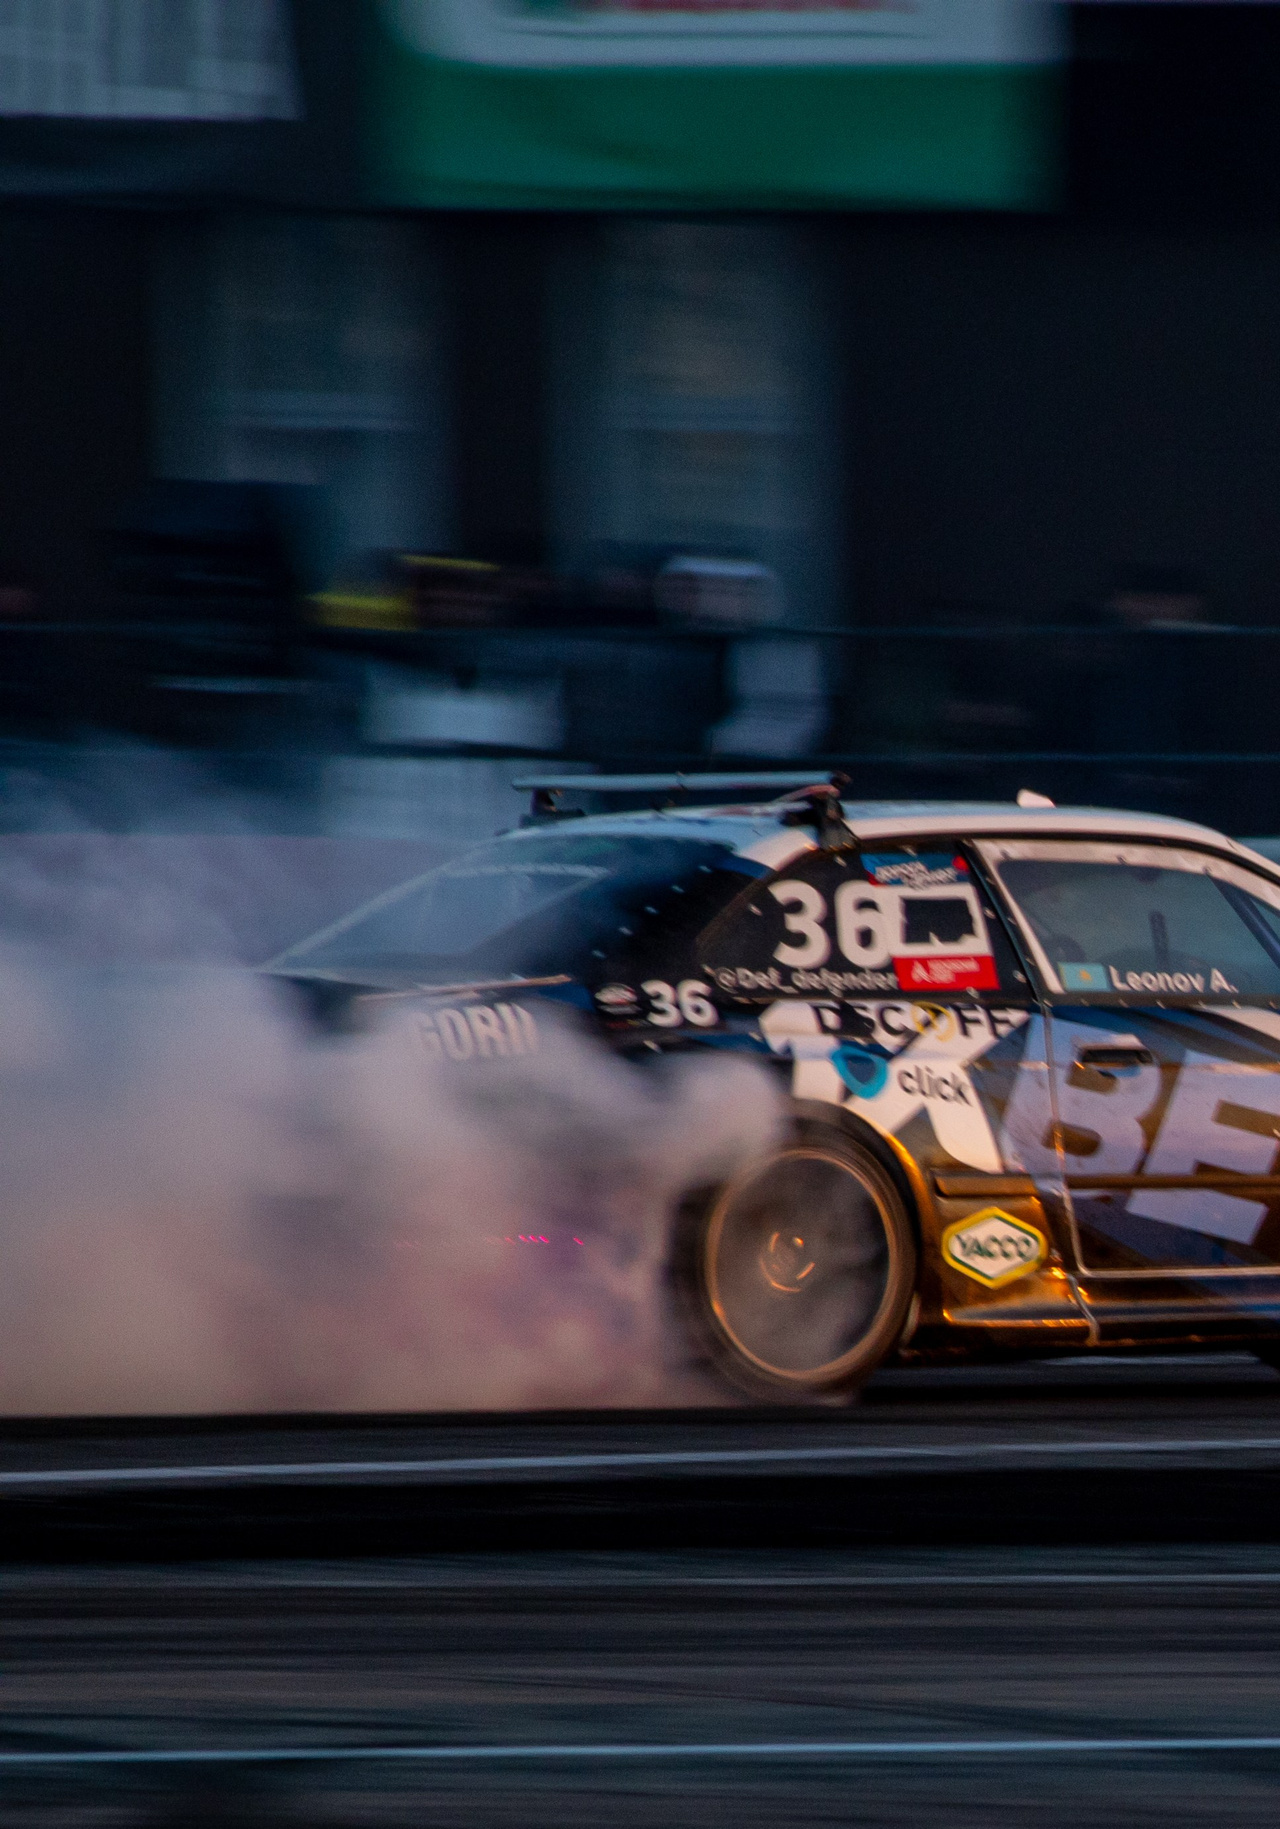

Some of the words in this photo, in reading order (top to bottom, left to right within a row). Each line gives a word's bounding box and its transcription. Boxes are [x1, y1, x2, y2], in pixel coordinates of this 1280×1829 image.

[767, 879, 893, 969] 36
[1109, 965, 1205, 993] Leonov
[1210, 967, 1239, 994] A.
[641, 979, 719, 1028] 36
[898, 1065, 972, 1106] click
[954, 1234, 1037, 1262] YACCO
